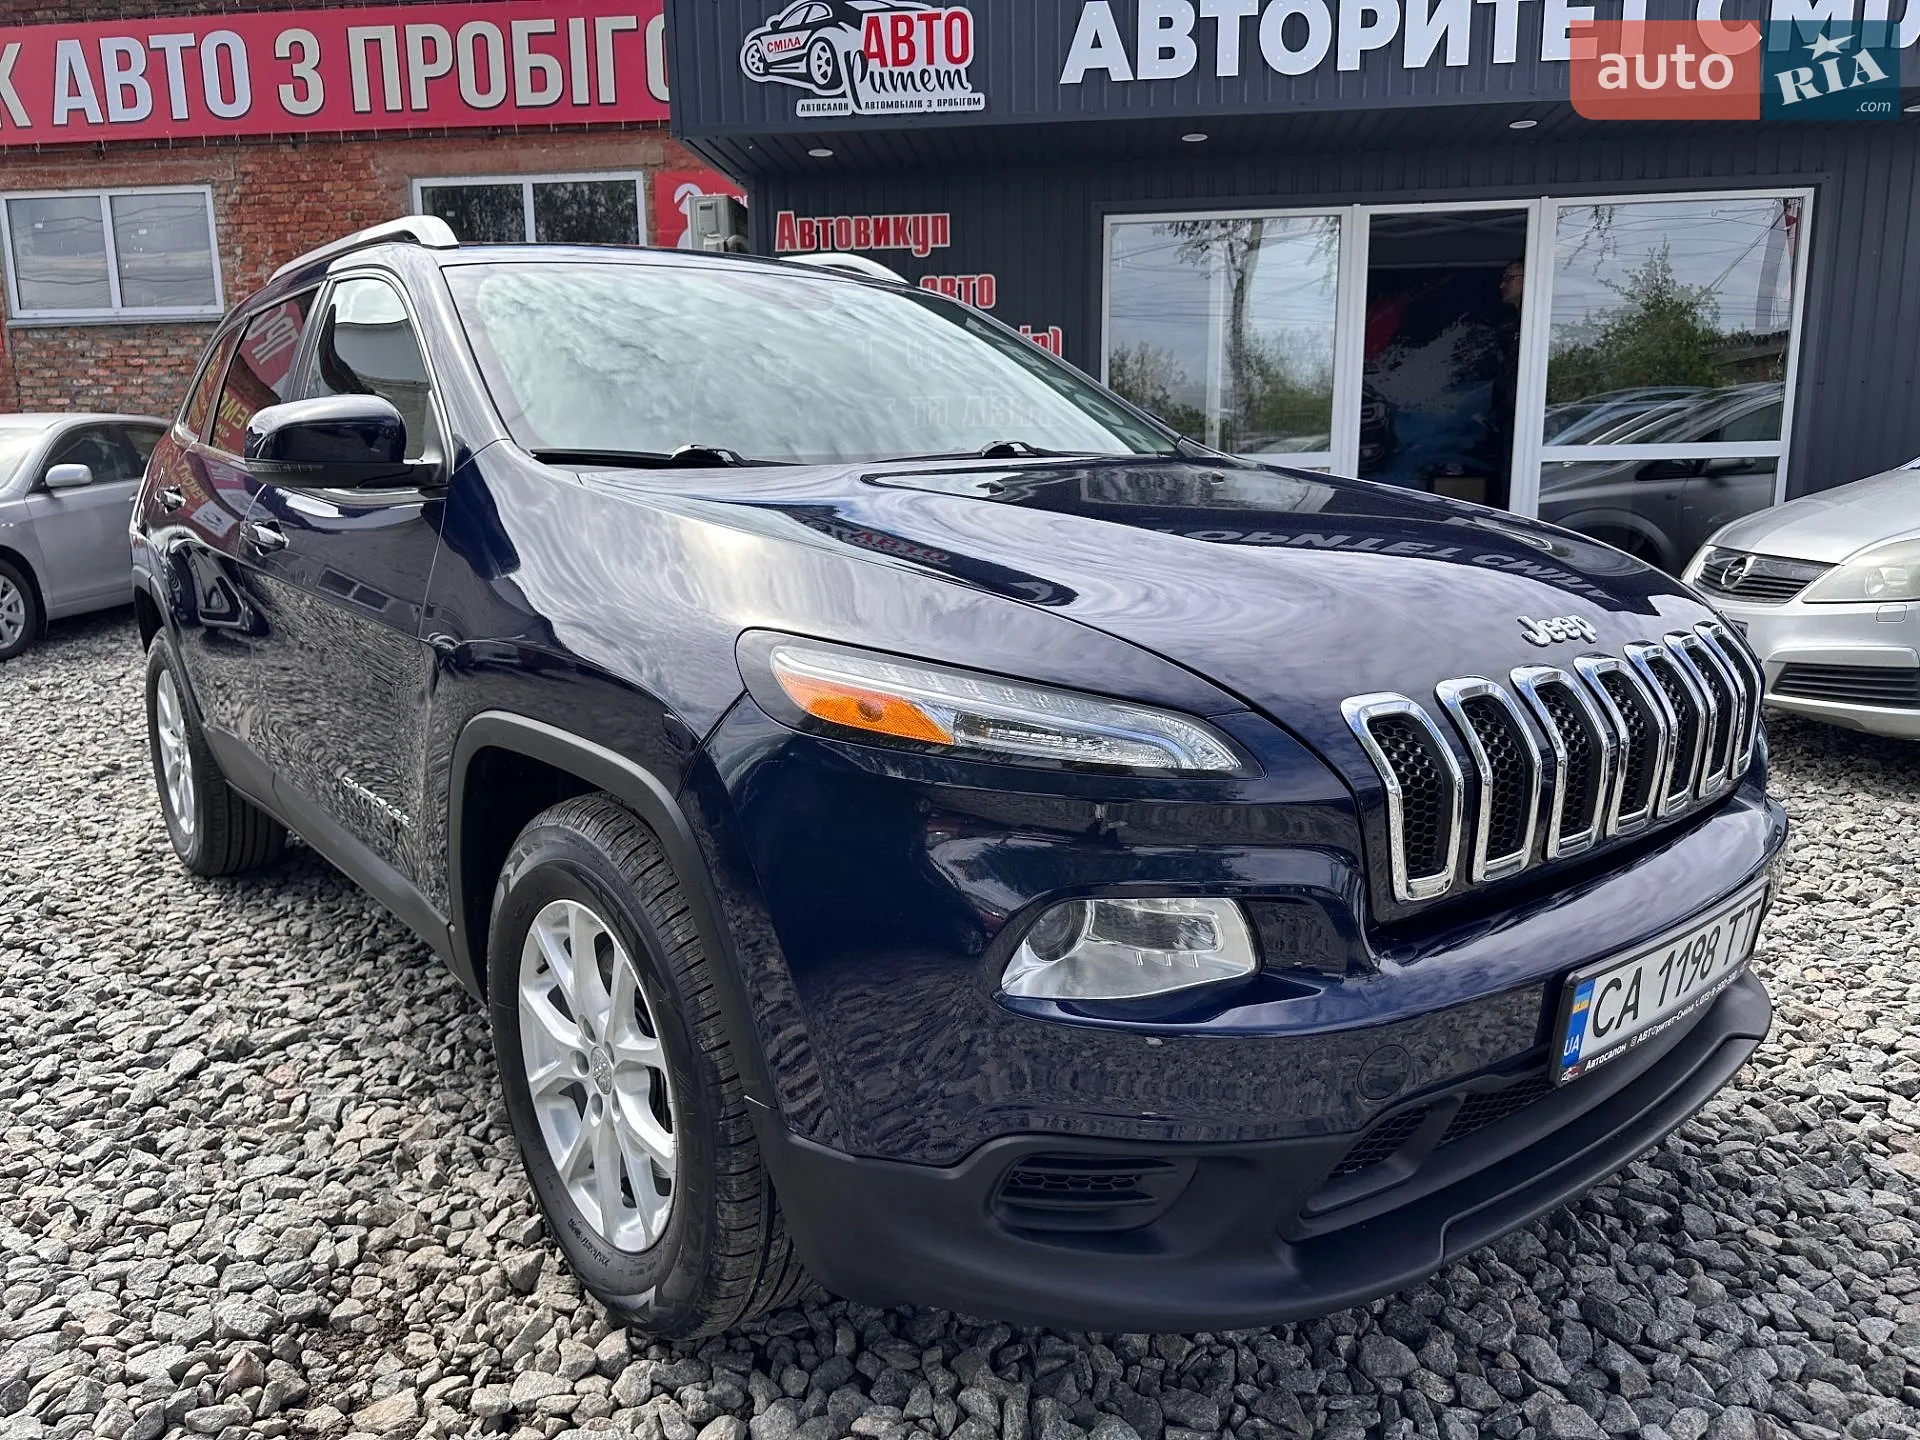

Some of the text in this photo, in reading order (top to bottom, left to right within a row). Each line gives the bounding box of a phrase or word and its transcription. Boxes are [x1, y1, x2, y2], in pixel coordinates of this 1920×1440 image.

[766, 36, 801, 54] СМІЛА
[863, 10, 971, 69] АВТО
[53, 30, 253, 127] АВТО
[800, 102, 849, 112] АВТОСАЛОН
[864, 100, 923, 110] АВТОМОБІЛІВ
[936, 97, 981, 107] ПРОБІГОМ
[1516, 615, 1597, 647] Jeep
[1592, 966, 1642, 1038] CA
[1657, 925, 1721, 1008] 1198
[1723, 898, 1761, 965] TT
[1562, 1034, 1580, 1057] UA
